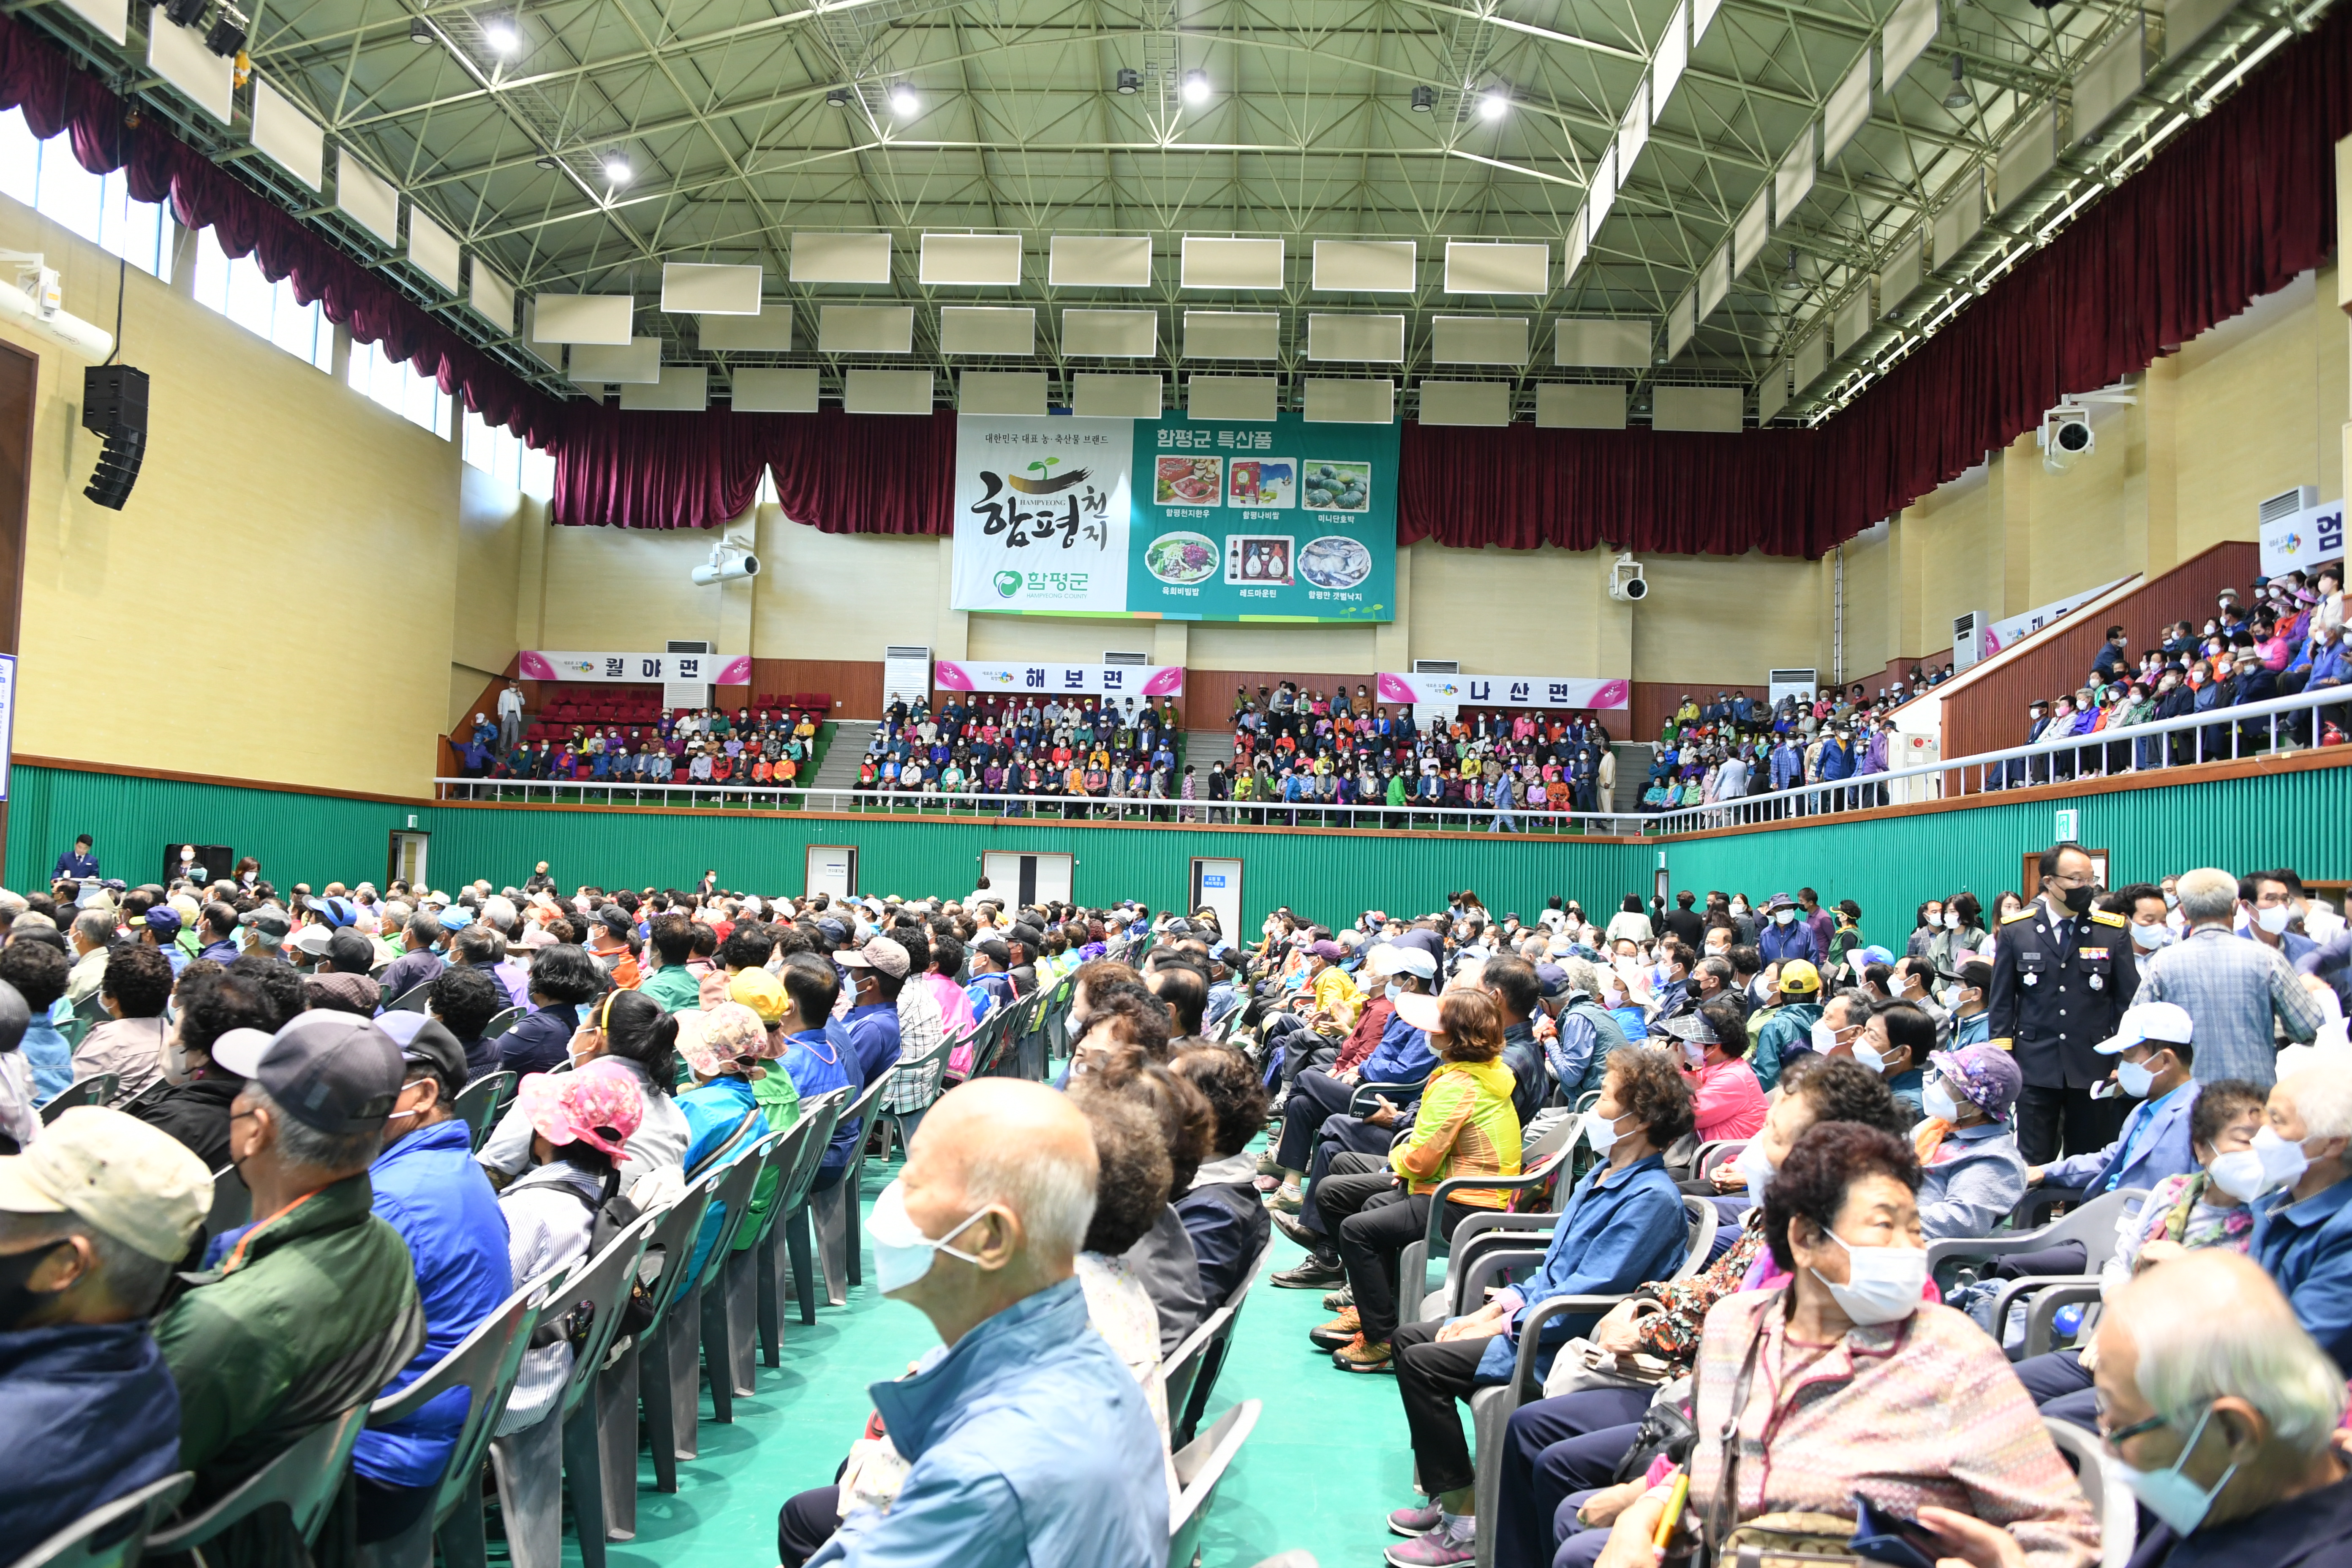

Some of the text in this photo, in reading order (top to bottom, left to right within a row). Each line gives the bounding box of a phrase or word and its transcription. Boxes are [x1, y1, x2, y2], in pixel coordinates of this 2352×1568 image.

[985, 433, 1019, 444] 대한민국
[1022, 434, 1038, 444] 대표
[1083, 435, 1108, 445] 브랜드
[1157, 429, 1272, 449] 함평군 특산품
[1166, 508, 1210, 517] 함평천지한우
[1243, 511, 1279, 520] 함평나비쌀
[1318, 514, 1355, 523] 미니단호박
[1028, 572, 1088, 591] 함평군
[1162, 587, 1199, 596] 육회비빔밥
[1239, 589, 1277, 598] 레드마운틴
[1308, 591, 1362, 601] 함평만 갯벌낙지
